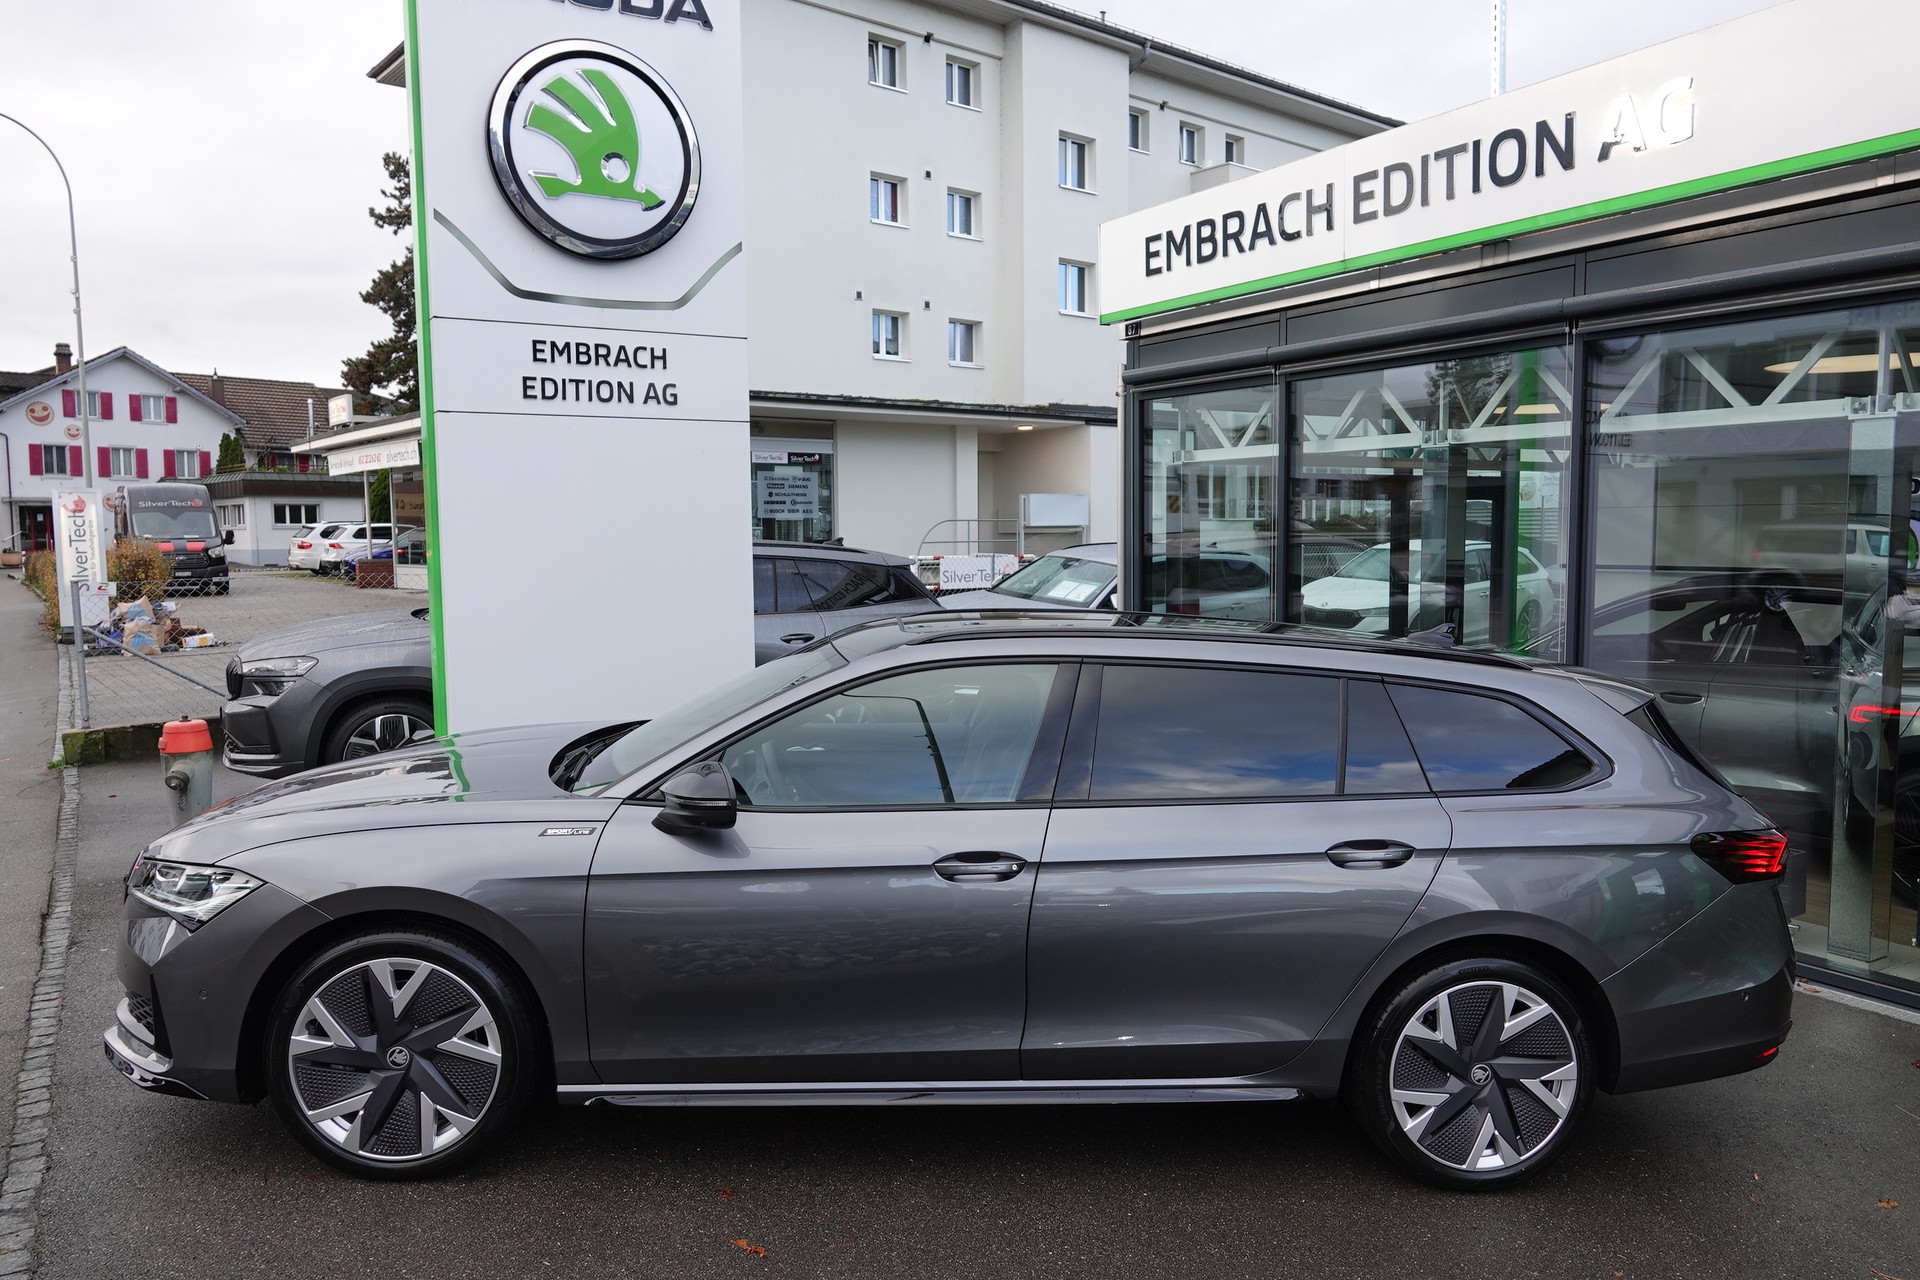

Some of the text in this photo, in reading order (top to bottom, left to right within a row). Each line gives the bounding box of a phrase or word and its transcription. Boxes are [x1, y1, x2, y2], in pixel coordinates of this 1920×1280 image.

[1145, 76, 1697, 278] EMBRACH EDITION AG
[1127, 324, 1136, 335] 87
[532, 339, 667, 370] EMBRACH
[522, 376, 678, 406] EDITION AG
[138, 499, 194, 508] SilverTech
